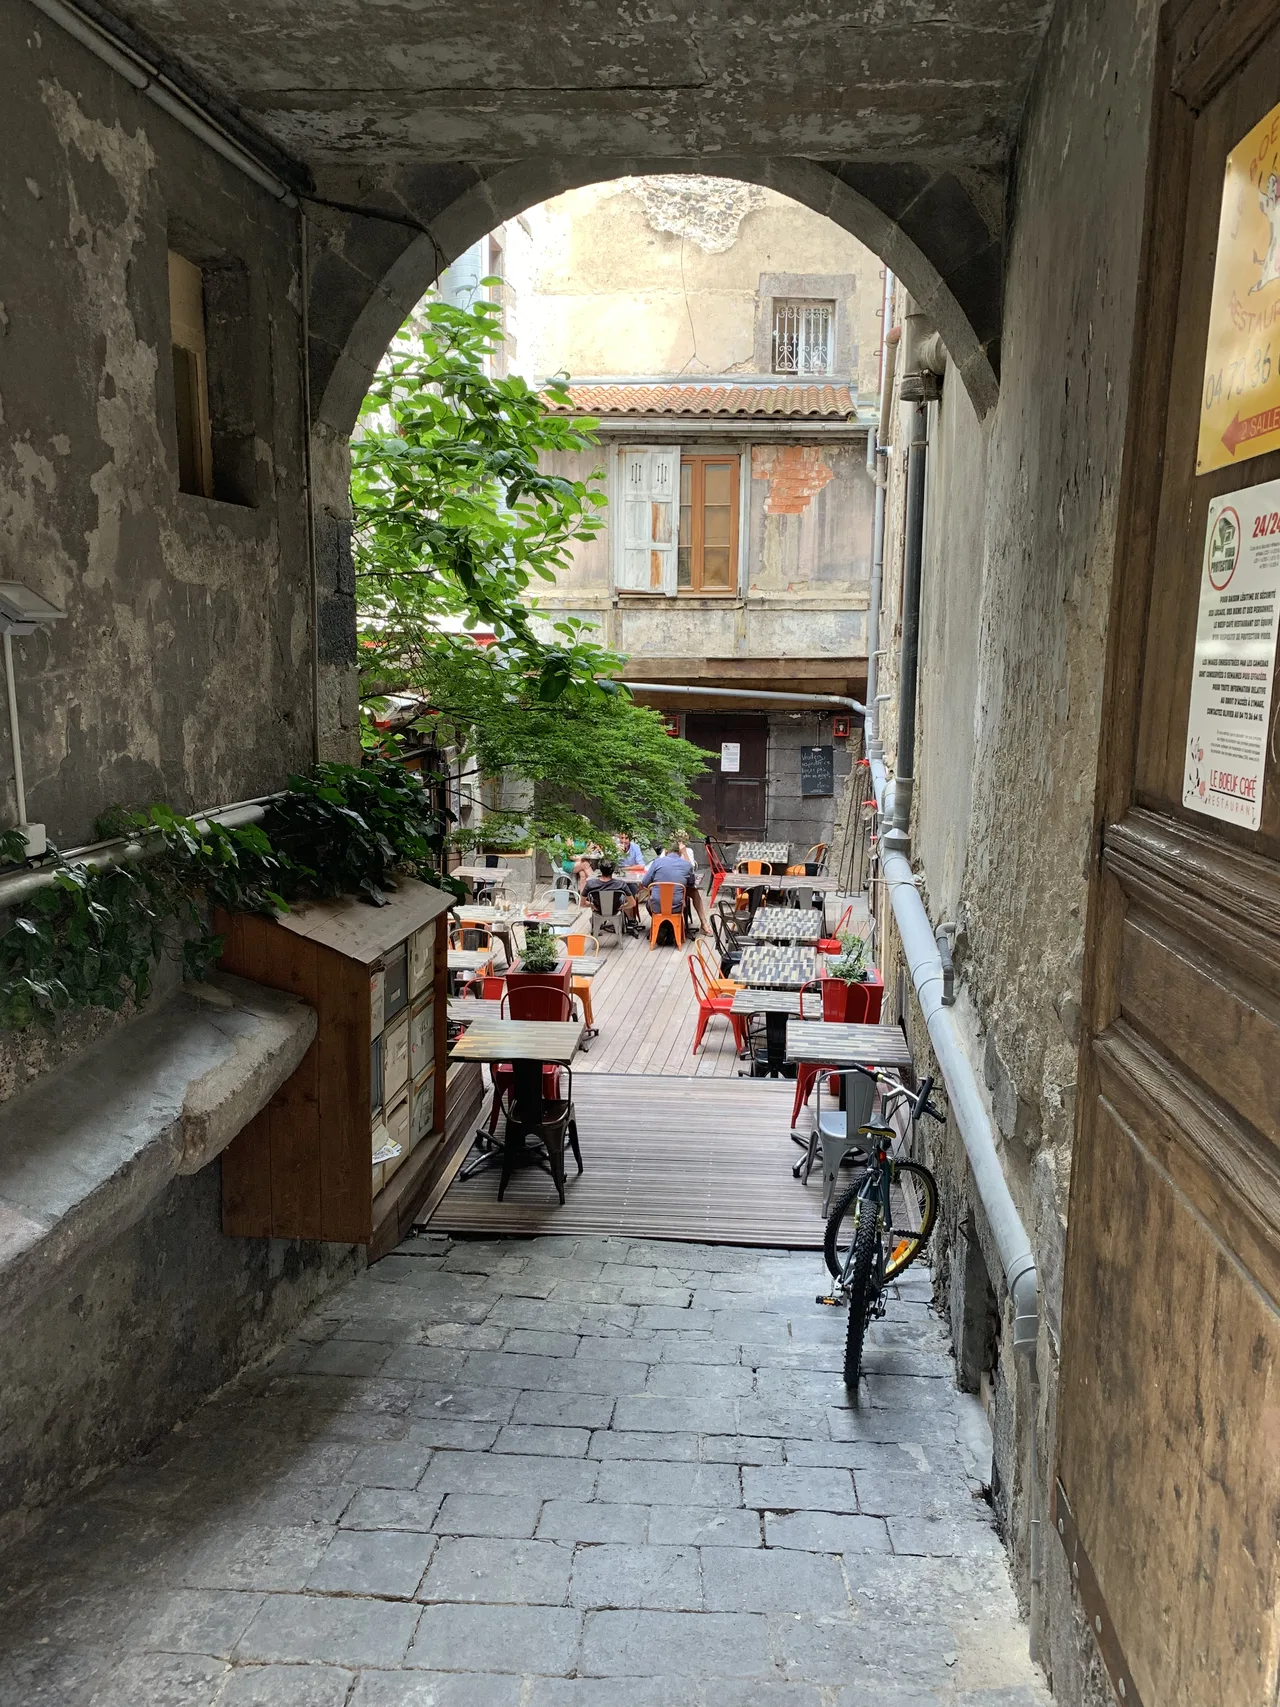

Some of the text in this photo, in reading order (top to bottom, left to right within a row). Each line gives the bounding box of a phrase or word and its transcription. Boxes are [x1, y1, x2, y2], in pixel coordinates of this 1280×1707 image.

[1205, 342, 1271, 410] 04 73 36
[1210, 558, 1235, 574] PROTECTION
[1220, 595, 1228, 603] POUR
[1240, 592, 1254, 601] LÉGITIME
[1260, 589, 1276, 599] SÉCURITÉ
[1261, 616, 1273, 626] ÉQUIPÉ
[1253, 658, 1269, 667] CAMÉRAS
[1207, 669, 1224, 678] CONSERVÉES
[1212, 683, 1220, 691] POUR
[1230, 685, 1250, 693] INFORMATION
[1251, 686, 1267, 695] RELATIVE
[1225, 697, 1234, 705] DROIT
[1210, 769, 1258, 799] LE BOEUF CAFÉ
[1208, 795, 1256, 817] RESTAURANT
